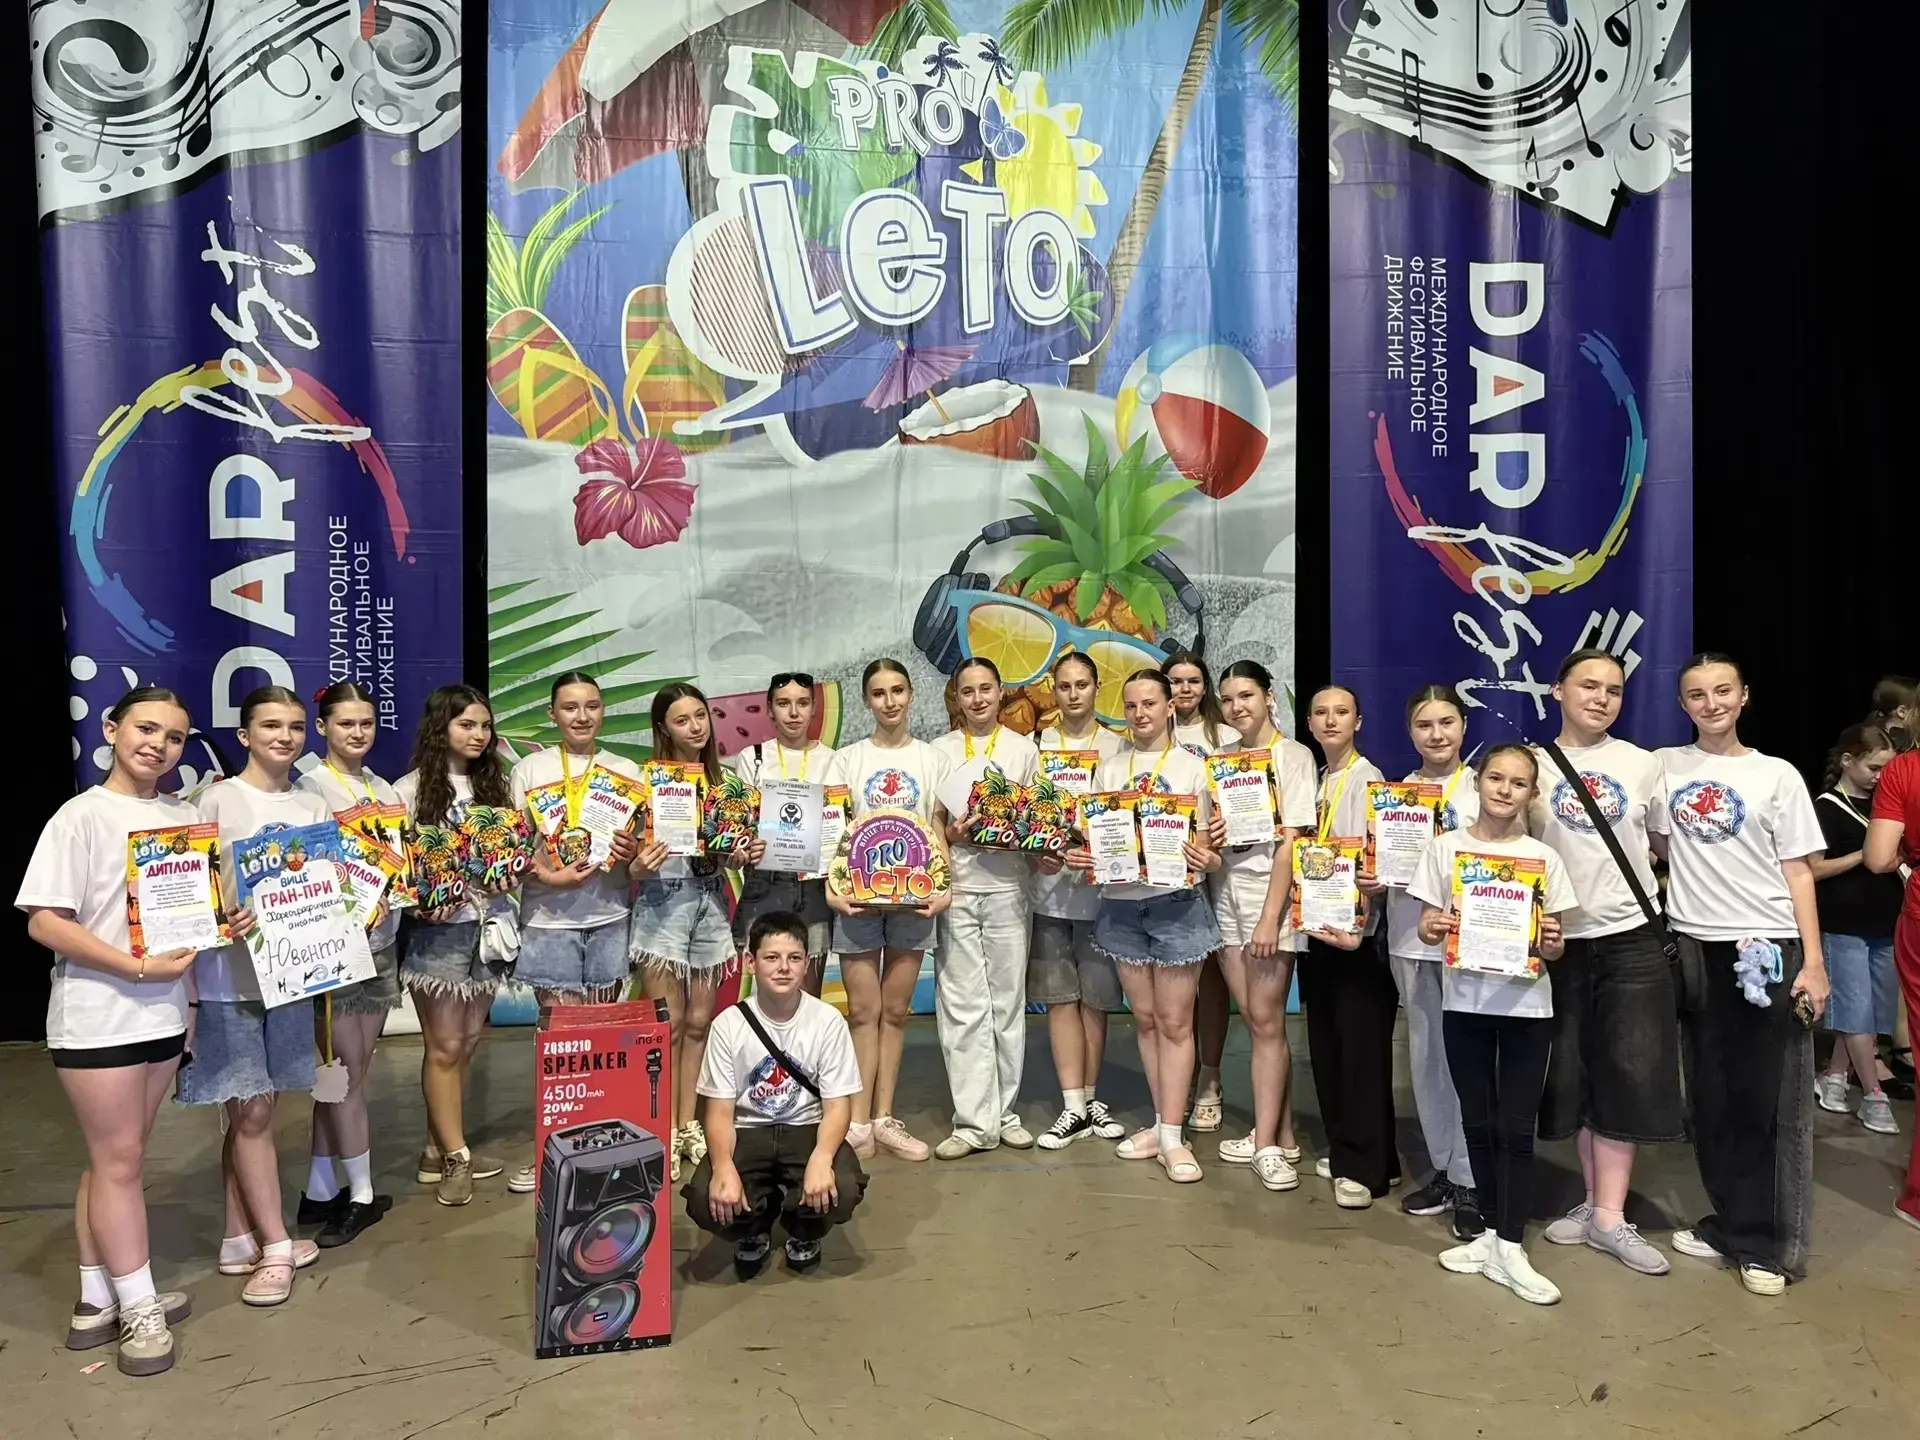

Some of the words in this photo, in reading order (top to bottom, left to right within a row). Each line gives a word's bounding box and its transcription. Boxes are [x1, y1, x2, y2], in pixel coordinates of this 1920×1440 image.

[180, 195, 372, 443] fest
[1384, 253, 1404, 380] ДВИЖЕНИЕ
[1409, 255, 1427, 433] ФЕСТИВАЛЬНОЕ
[1428, 256, 1448, 458] МЕЖДУНАРОДНОЕ
[1469, 262, 1546, 509] DAR
[209, 454, 296, 728] DAR
[354, 540, 374, 695] СТИВАЛЬНОЕ
[1407, 522, 1575, 735] fest
[377, 596, 399, 730] ДВИЖЕНИЕ
[1052, 772, 1087, 782] ДИПЛОМ
[1223, 775, 1263, 789] ДИПЛОМ
[657, 787, 692, 797] ДИПЛОМ
[549, 804, 567, 820] ДИП
[590, 791, 630, 815] ДИПЛОМ
[1560, 801, 1619, 815] Ювта
[822, 810, 840, 820] ЛОМ
[982, 819, 1009, 829] ПРО
[1145, 819, 1184, 829] ДИПЛОМ
[1382, 811, 1428, 823] ДИПЛОМ
[717, 823, 745, 834] ПРО
[974, 829, 1014, 844] ЛЕТО
[1030, 825, 1057, 835] ПРО
[708, 831, 750, 850] ЛЕТО
[1021, 834, 1062, 850] ЛЕТО
[487, 847, 514, 868] ПРО
[864, 837, 908, 874] PRO
[146, 860, 202, 878] ДИПЛОМ
[345, 861, 381, 888] ИПЛОМ
[484, 855, 525, 885] ЛЕТО
[280, 872, 309, 888] ВИЦЕ
[431, 870, 455, 891] ПРО
[261, 880, 333, 909] ГРАН-ПРИ
[428, 879, 464, 908] ЛЕТО
[1470, 885, 1525, 902] ДИПЛОМ
[543, 1051, 627, 1074] SPEAKER
